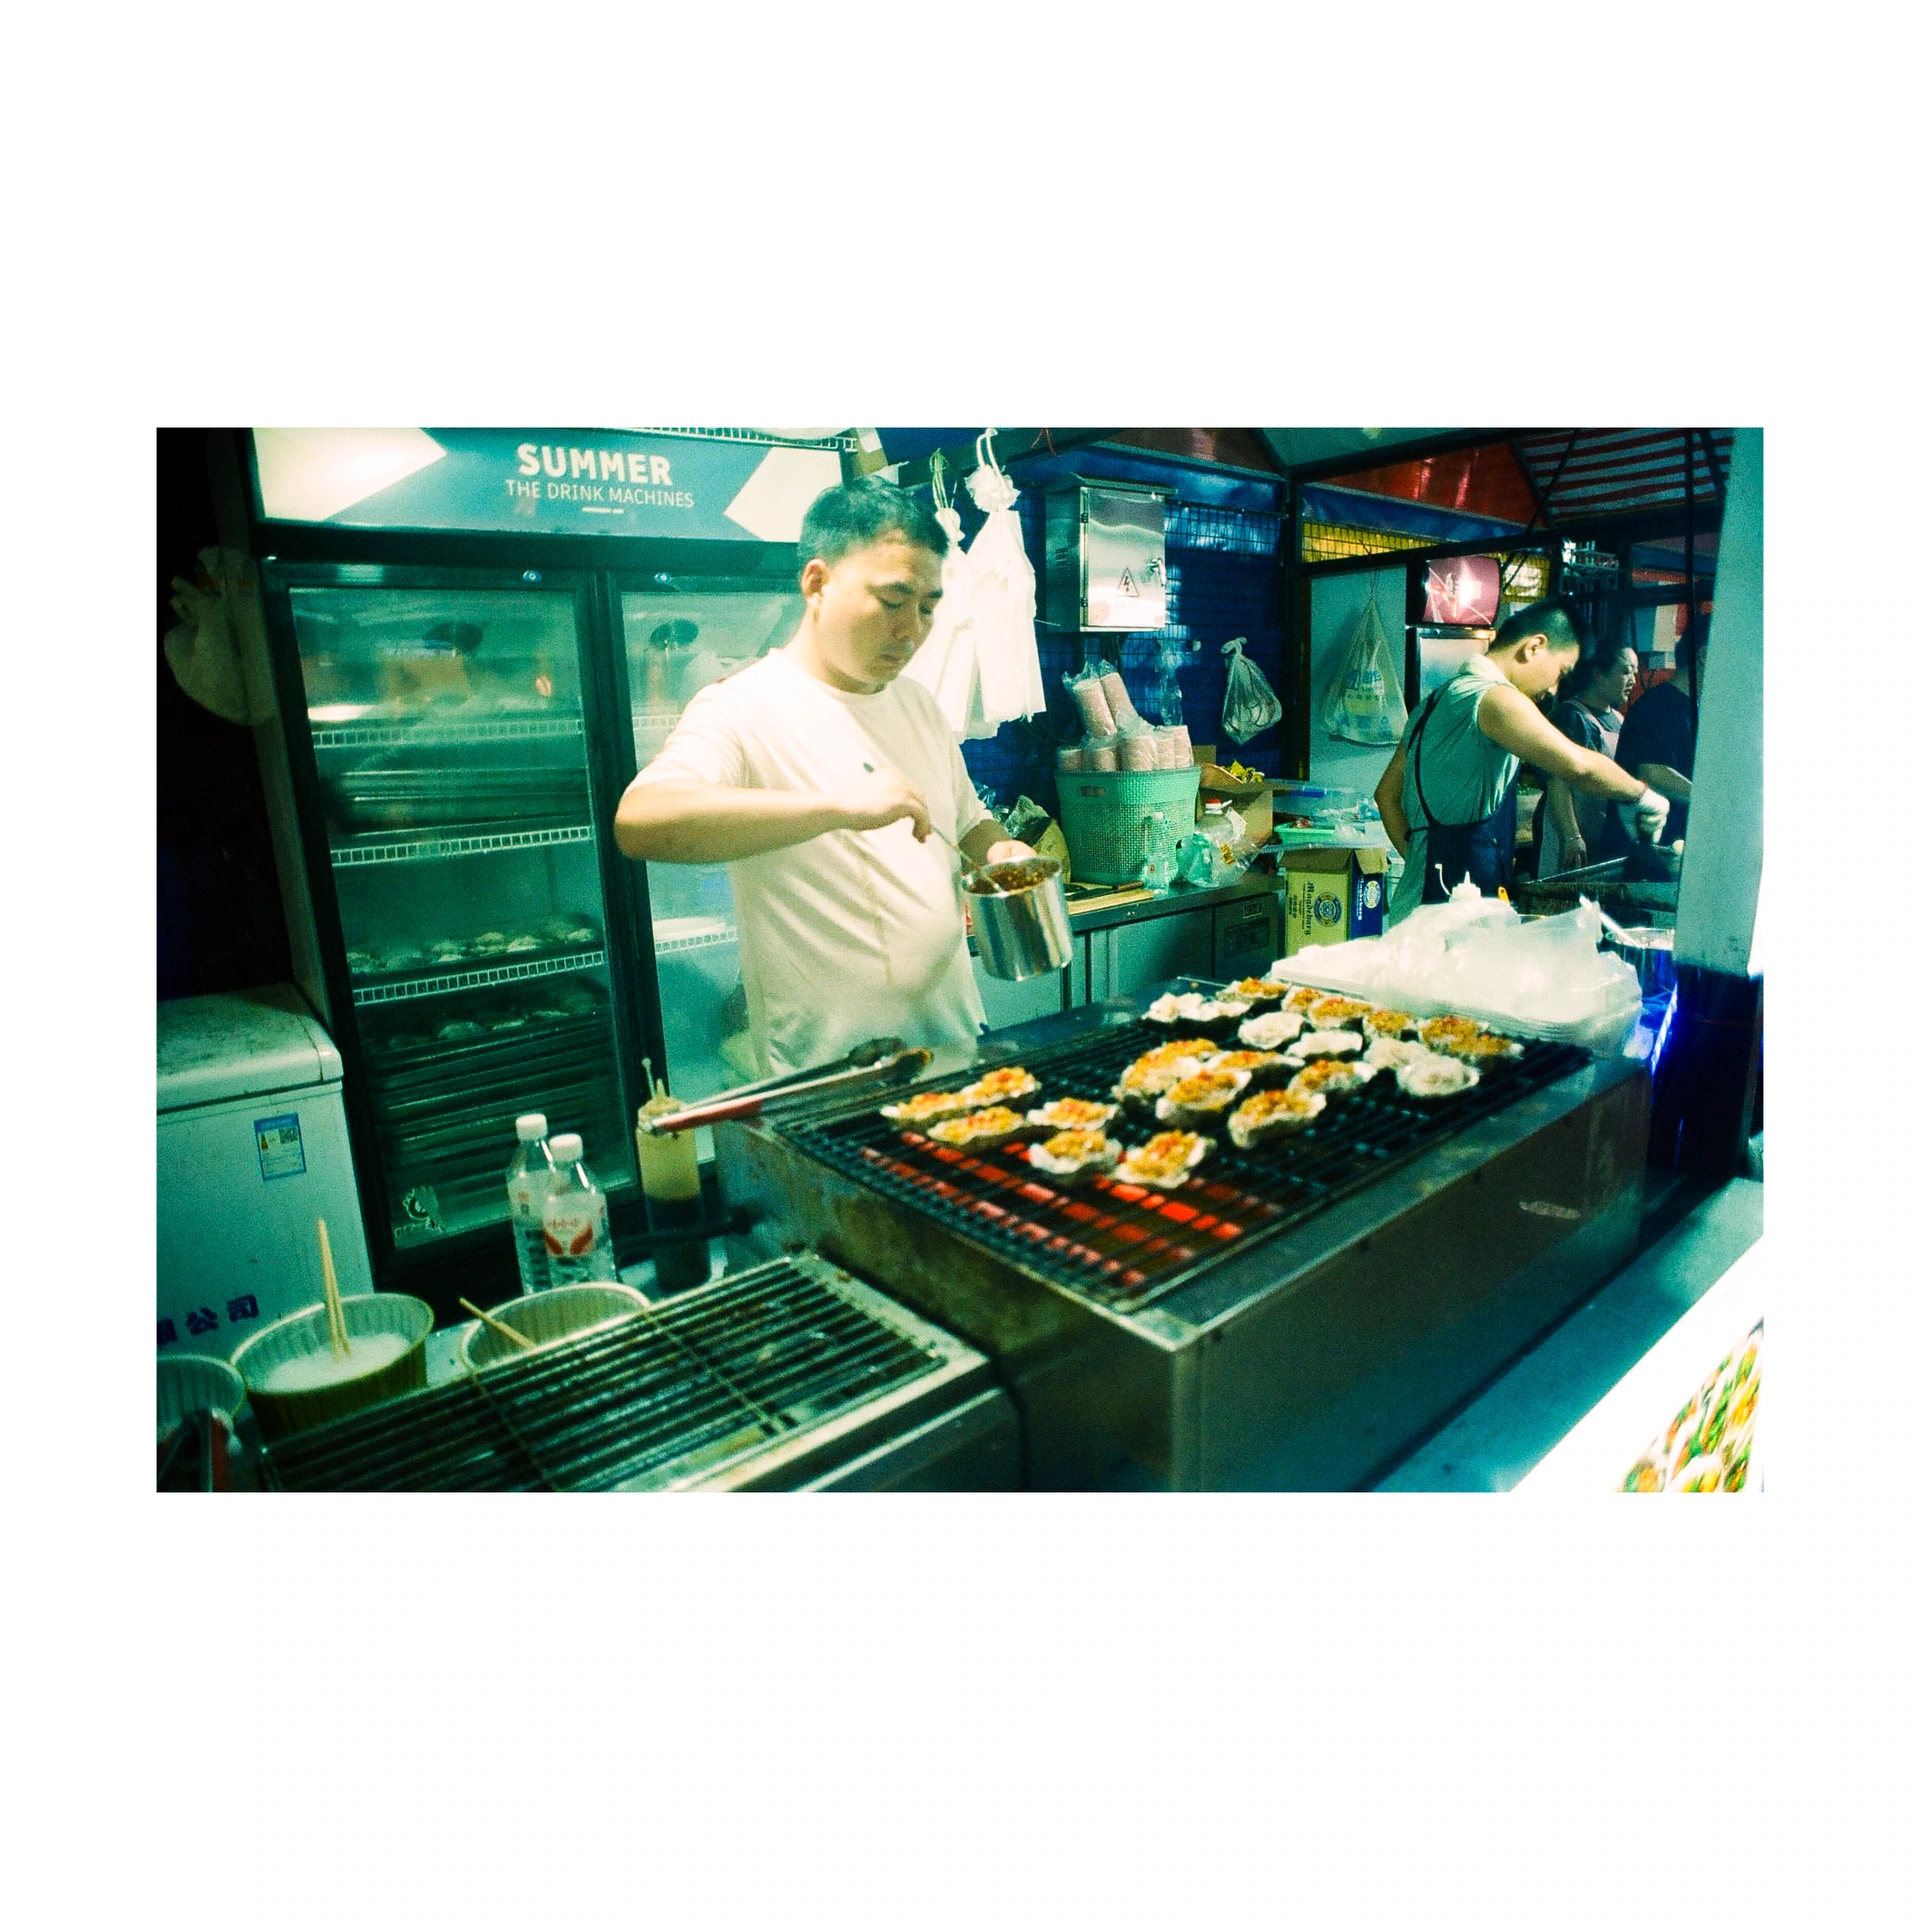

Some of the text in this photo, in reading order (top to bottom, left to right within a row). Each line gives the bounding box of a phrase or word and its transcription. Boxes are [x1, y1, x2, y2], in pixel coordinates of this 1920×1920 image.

[517, 443, 673, 485] SUMMER
[505, 479, 694, 508] THE DRINK MACHINES
